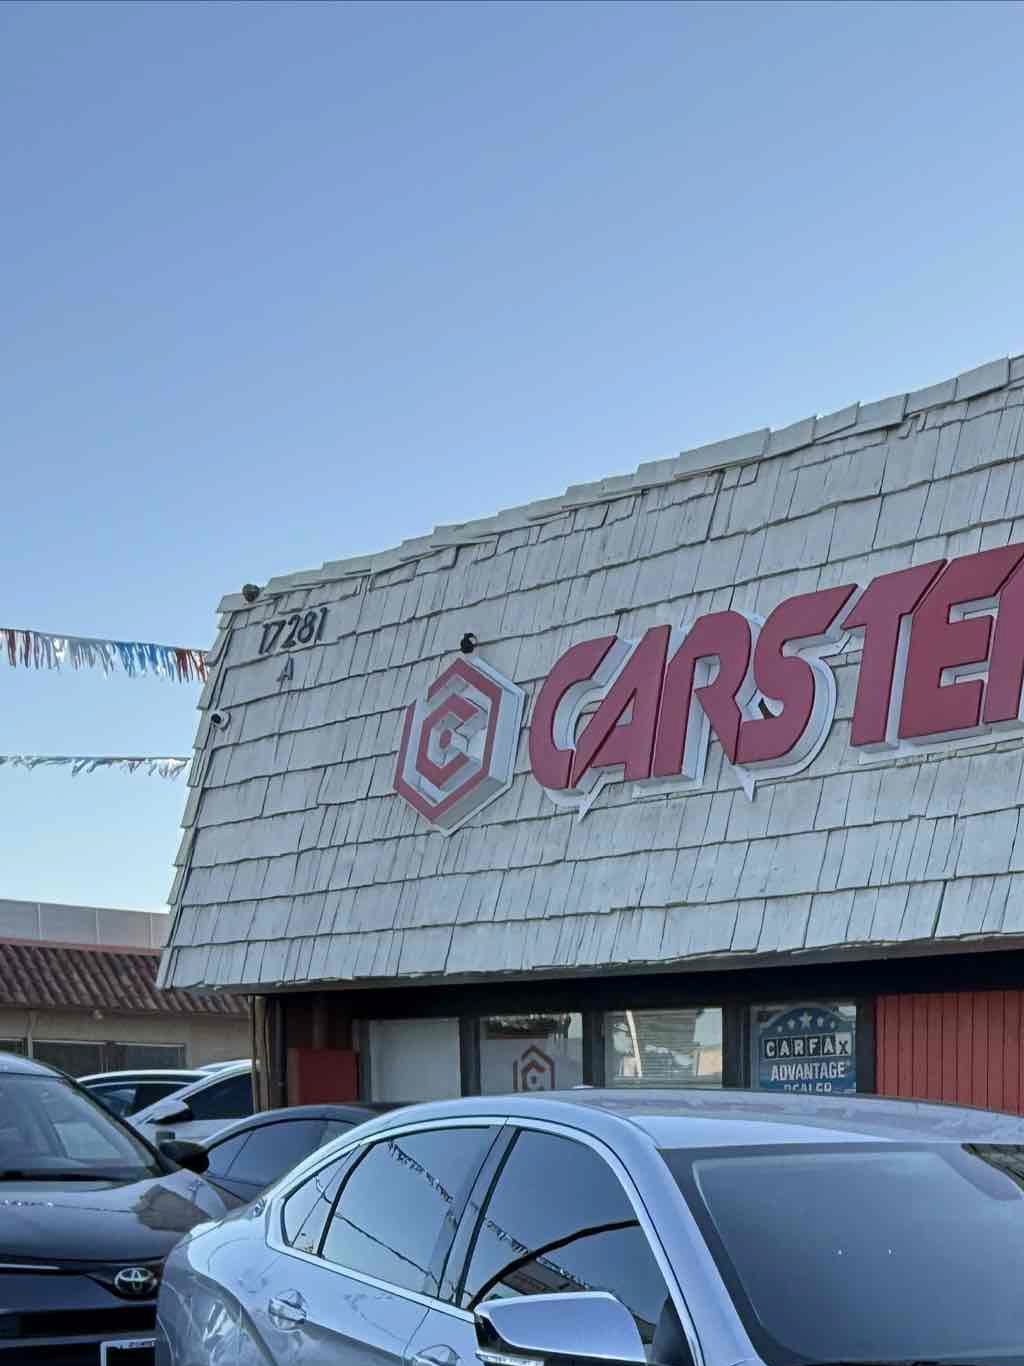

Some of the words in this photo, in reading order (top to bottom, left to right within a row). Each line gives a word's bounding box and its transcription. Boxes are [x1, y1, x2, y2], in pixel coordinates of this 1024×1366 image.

[258, 607, 328, 655] 17281
[765, 1038, 849, 1058] CARFAX
[771, 1061, 846, 1082] ADVANTAGE
